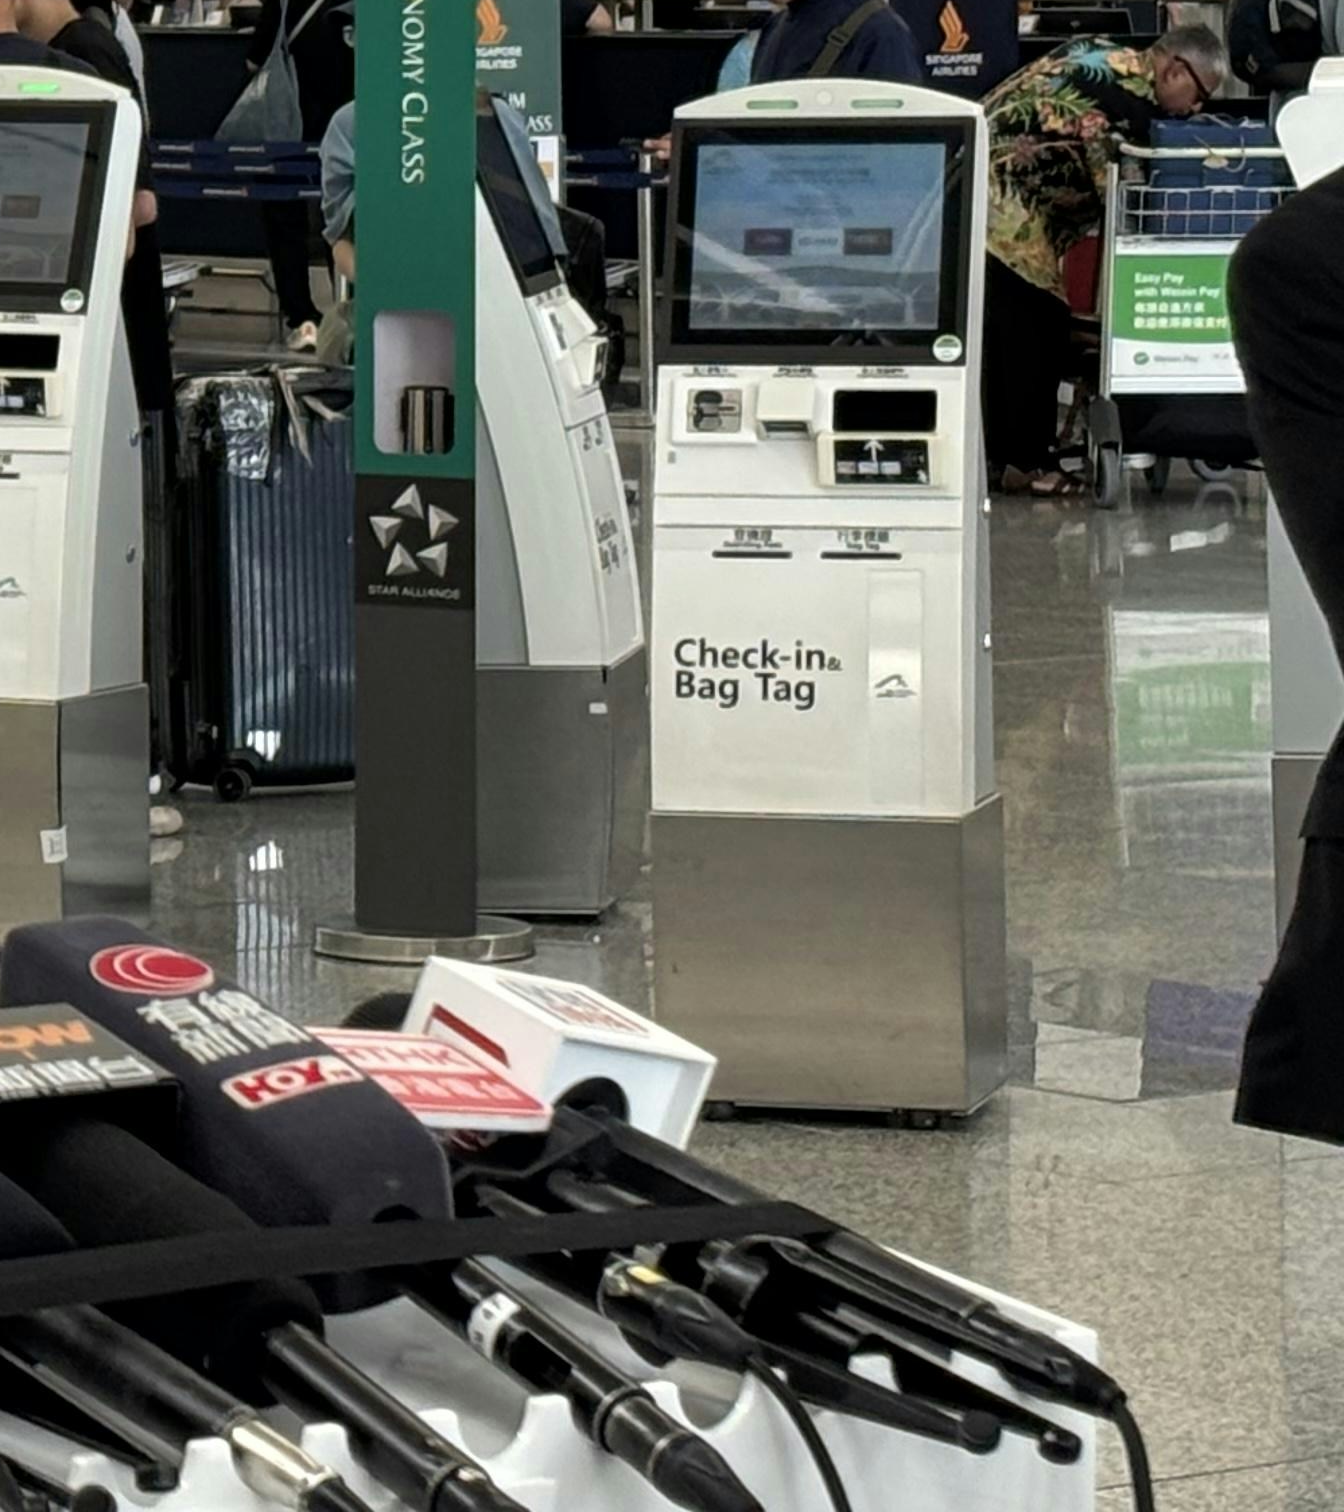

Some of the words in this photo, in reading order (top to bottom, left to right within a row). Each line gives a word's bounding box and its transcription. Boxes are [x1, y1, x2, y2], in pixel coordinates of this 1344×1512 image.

[925, 53, 984, 66] SINGAPORE
[931, 65, 978, 77] AIRLINES
[526, 115, 553, 132] ASS
[401, 92, 429, 184] CLASS
[1163, 272, 1185, 286] Pay
[368, 584, 399, 596] STAR
[401, 586, 460, 600] ALLIANCE
[675, 671, 740, 709] Bag
[754, 672, 816, 711] Tag
[136, 989, 274, 1031] 有線
[231, 1060, 327, 1104] HOY
